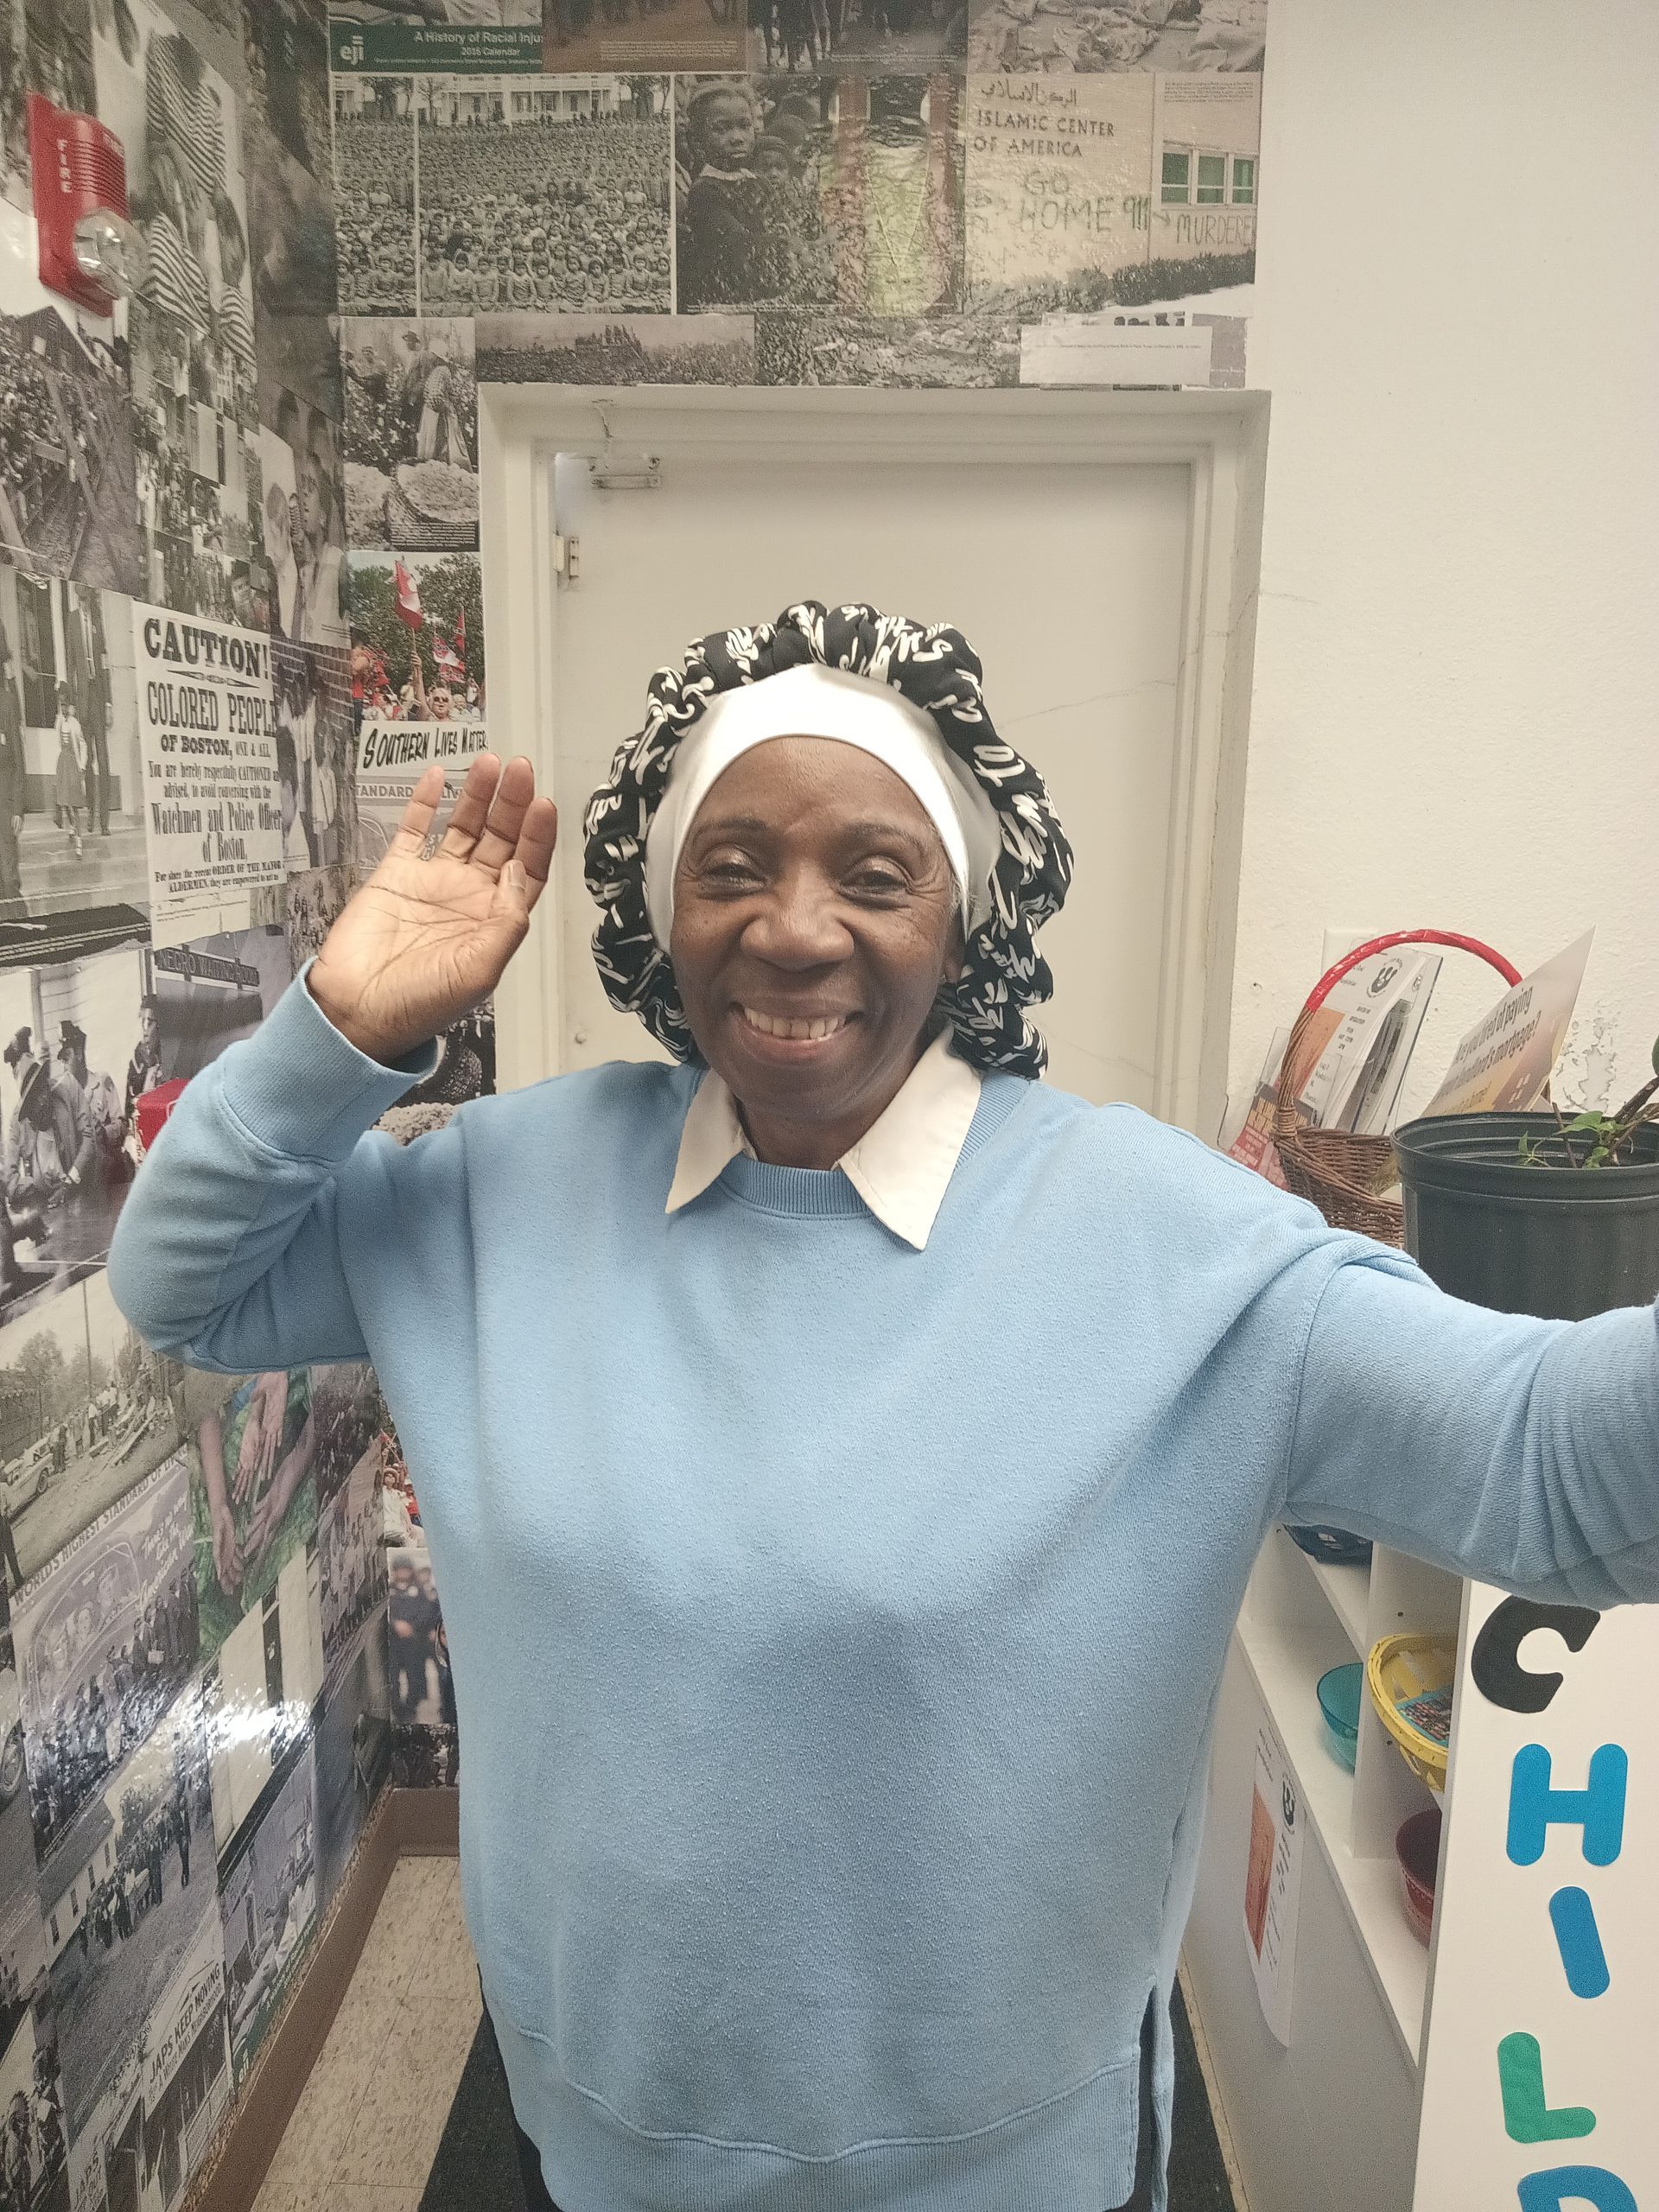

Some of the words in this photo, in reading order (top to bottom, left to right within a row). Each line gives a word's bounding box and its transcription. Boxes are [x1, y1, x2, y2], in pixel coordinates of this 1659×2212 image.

[424, 31, 465, 45] History
[469, 31, 480, 43] of
[483, 31, 517, 43] Racial
[482, 47, 520, 57] Calendar
[978, 110, 1049, 131] ISLAMIC
[1057, 118, 1115, 137] CENTER
[974, 136, 997, 152] OF
[1007, 138, 1083, 159] AMERICA
[56, 138, 73, 194] FIRE
[1024, 169, 1070, 196] GO
[1019, 195, 1115, 233] HOME
[1123, 195, 1149, 232] 911
[144, 617, 269, 680] CAUTION!
[148, 681, 219, 732] COLORED
[161, 734, 178, 753] OF
[181, 735, 233, 760] BOSTON,
[236, 741, 248, 756] ONE
[251, 742, 256, 757] &
[363, 728, 429, 769] SOUTHERN
[434, 728, 458, 757] LIVES
[148, 760, 162, 779] You
[165, 763, 177, 778] are
[180, 762, 202, 781] hereby
[203, 765, 237, 783] respectfully
[238, 766, 271, 782] CAUTIONED
[163, 782, 190, 799] advised,
[192, 785, 200, 798] to
[200, 784, 216, 798] avoid
[219, 785, 250, 800] conversing
[250, 785, 262, 799] with
[263, 785, 272, 799] the
[355, 785, 414, 798] TANDARD
[150, 802, 203, 836] Watchmen
[207, 801, 225, 833] and
[226, 801, 255, 832] Police
[202, 832, 213, 863] of
[217, 831, 249, 862] Boston,
[154, 871, 168, 883] For
[168, 871, 182, 881] since
[183, 868, 194, 879] the
[194, 868, 213, 879] recent
[213, 864, 236, 875] ORDER
[237, 862, 245, 874] OF
[247, 861, 260, 874] THE
[261, 860, 283, 871] MAYOR
[210, 877, 222, 889] they
[222, 876, 232, 887] are
[232, 873, 260, 888] empowered
[156, 948, 196, 975] NEGRO
[197, 955, 235, 982] WAITING
[235, 962, 259, 985] ROOM
[1495, 1002, 1507, 1033] of
[1502, 985, 1534, 1033] paying
[1491, 1009, 1541, 1066] mortgage?
[61, 1523, 100, 1563] HIGHEST
[103, 1479, 149, 1526] STANDARD
[150, 1468, 162, 1483] OF
[149, 2034, 173, 2084] JAPS
[175, 2002, 194, 2044] KEEP
[194, 1962, 220, 2012] MOVING
